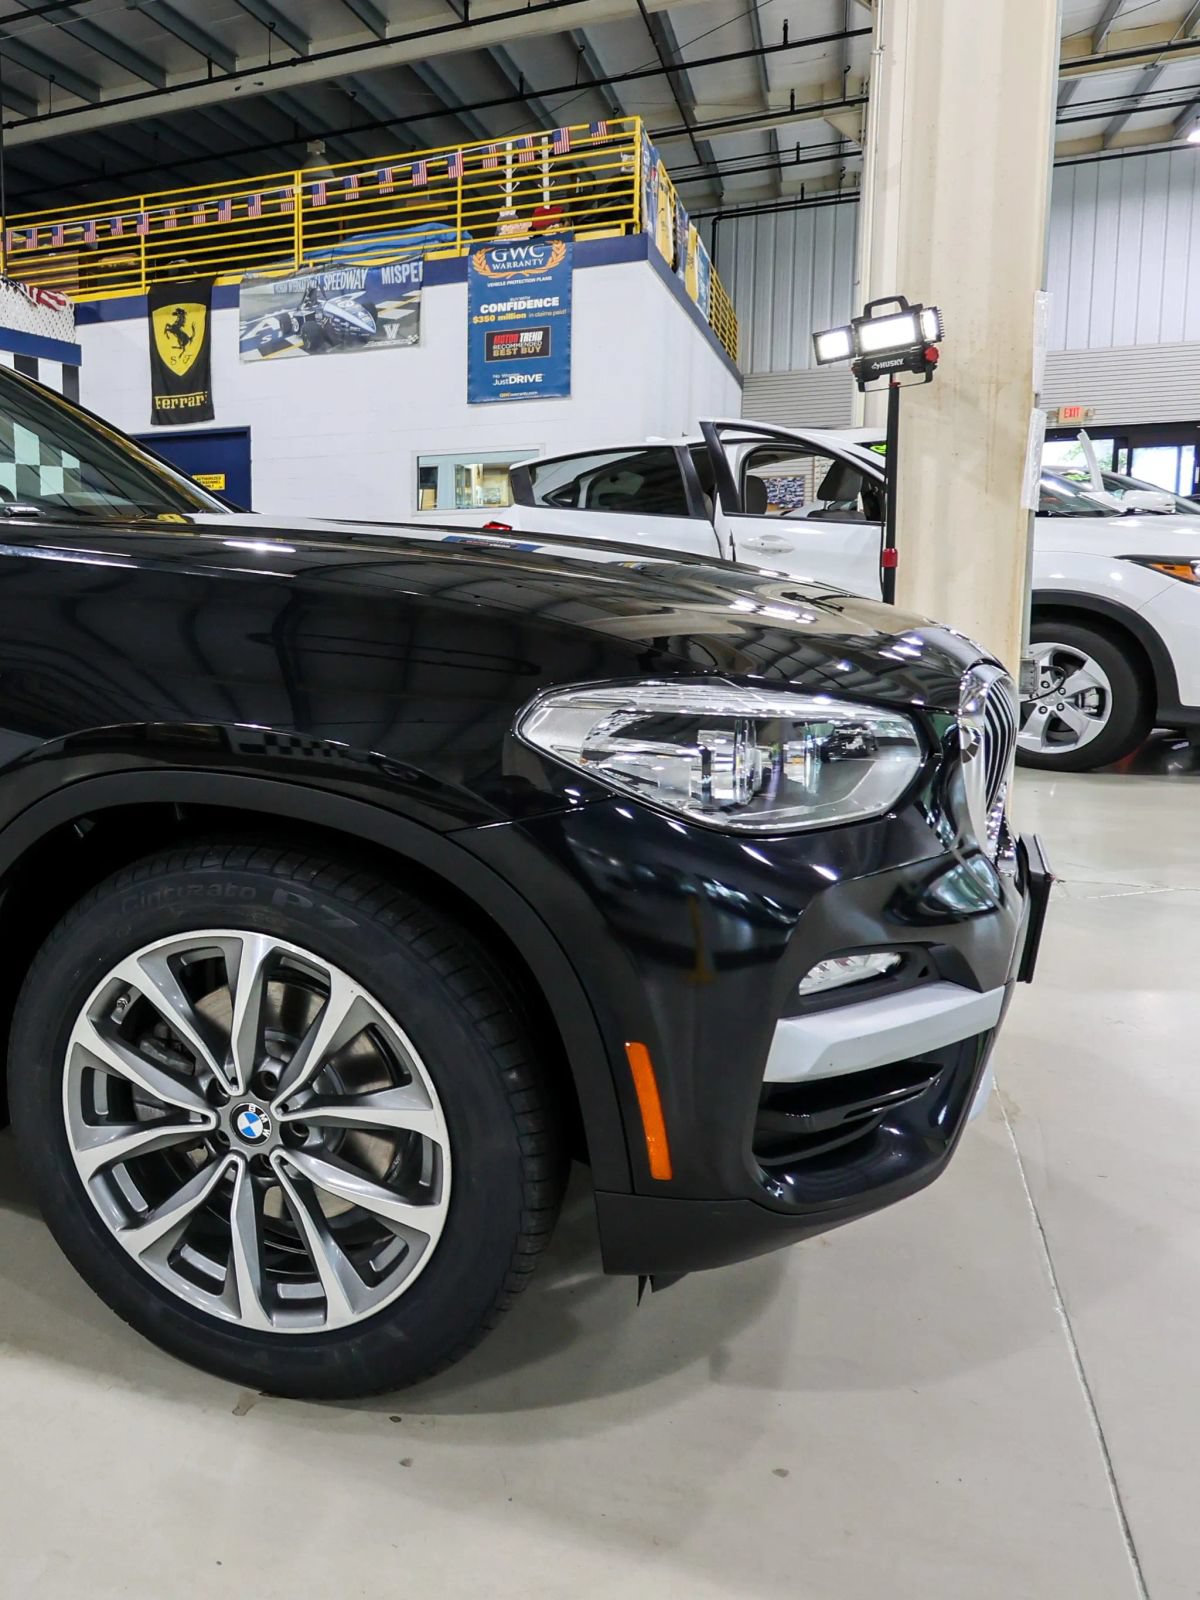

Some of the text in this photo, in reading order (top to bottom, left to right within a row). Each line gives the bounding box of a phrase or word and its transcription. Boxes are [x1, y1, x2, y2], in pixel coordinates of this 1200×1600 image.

[492, 244, 544, 262] GWC
[492, 258, 544, 270] WARRANTY
[323, 268, 368, 291] SPEEDWAY
[480, 297, 559, 314] CONFIDENCE
[472, 315, 496, 324] $350
[497, 312, 527, 321] million
[520, 331, 543, 342] TREND
[493, 341, 543, 350] RECOMMENDED
[493, 346, 542, 357] BEST BUY
[879, 358, 904, 369] HUSKY
[154, 391, 208, 410] Ferrari
[1064, 407, 1080, 418] EXIT
